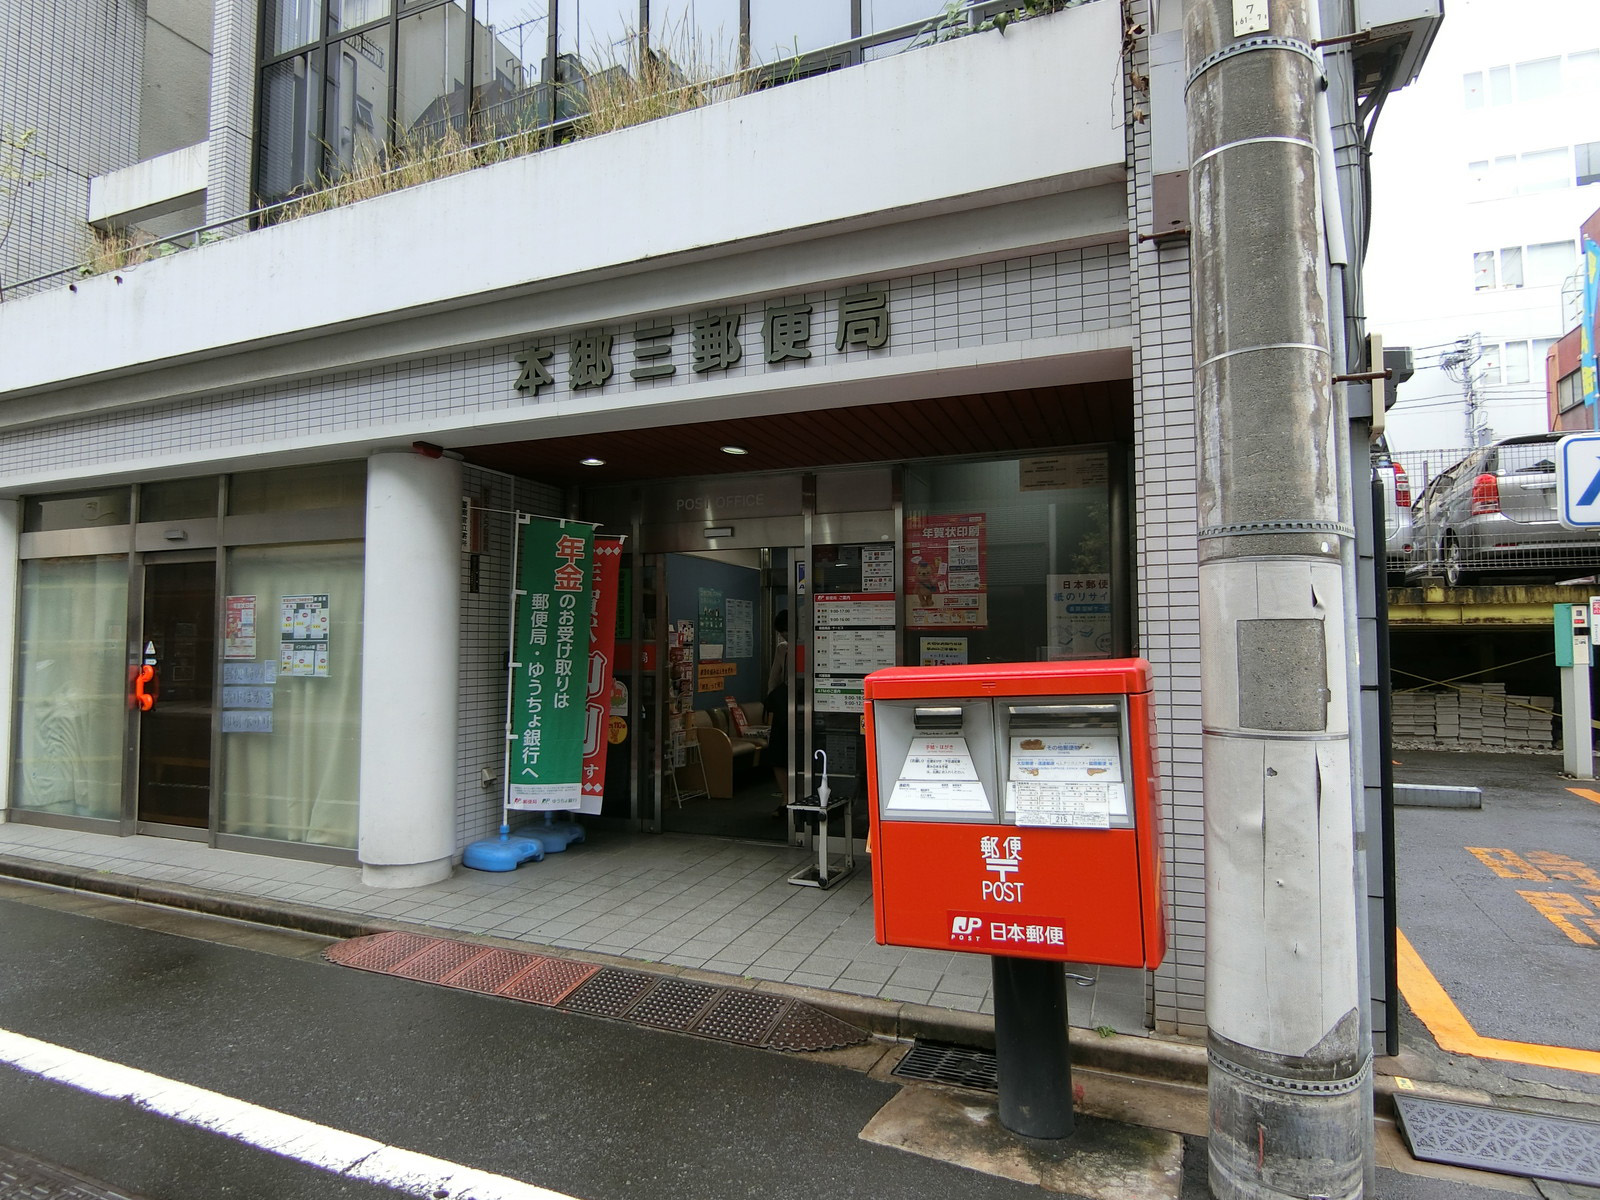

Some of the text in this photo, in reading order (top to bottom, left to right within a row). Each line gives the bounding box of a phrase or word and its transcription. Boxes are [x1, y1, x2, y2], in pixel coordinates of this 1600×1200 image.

[1246, 4, 1254, 14] 7
[513, 290, 891, 396] 本郷三郵便局
[676, 493, 764, 511] POST OFFICE
[922, 525, 980, 538] 年賀状印刷
[521, 593, 550, 779] 郵便局・ゆうちょ銀行へ
[1055, 815, 1068, 823] 215
[980, 836, 1023, 860] 郵便
[982, 882, 1024, 902] POST
[950, 934, 981, 942] POST
[990, 922, 1065, 946] 日本郵便
